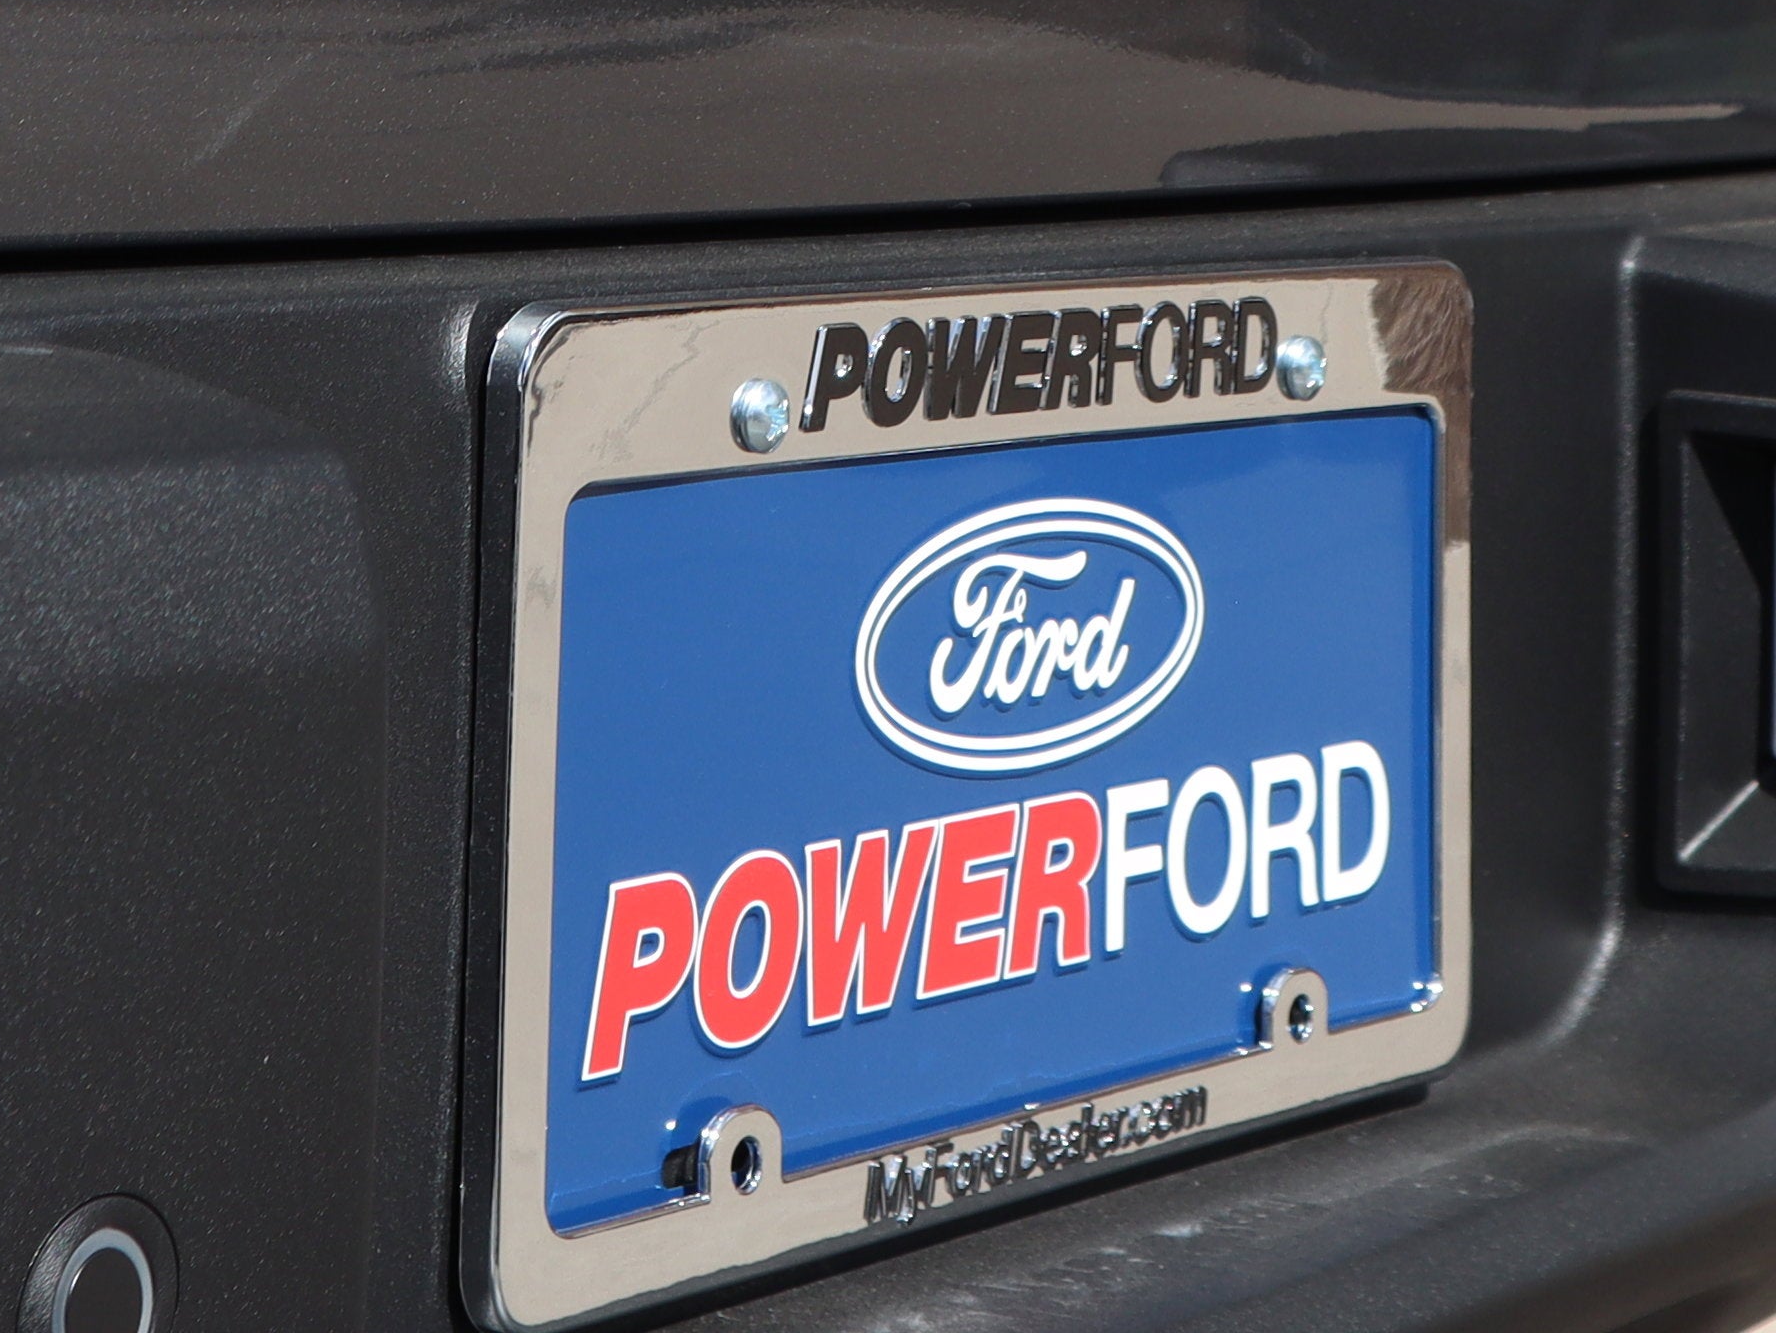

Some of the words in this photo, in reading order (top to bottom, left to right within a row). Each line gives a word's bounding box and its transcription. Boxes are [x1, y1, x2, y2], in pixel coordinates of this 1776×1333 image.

[799, 296, 1277, 433] POWERFORD
[929, 550, 1135, 717] Ford
[580, 739, 1391, 1083] POWERFORD
[864, 1085, 1208, 1225] MyFordDealer.com
